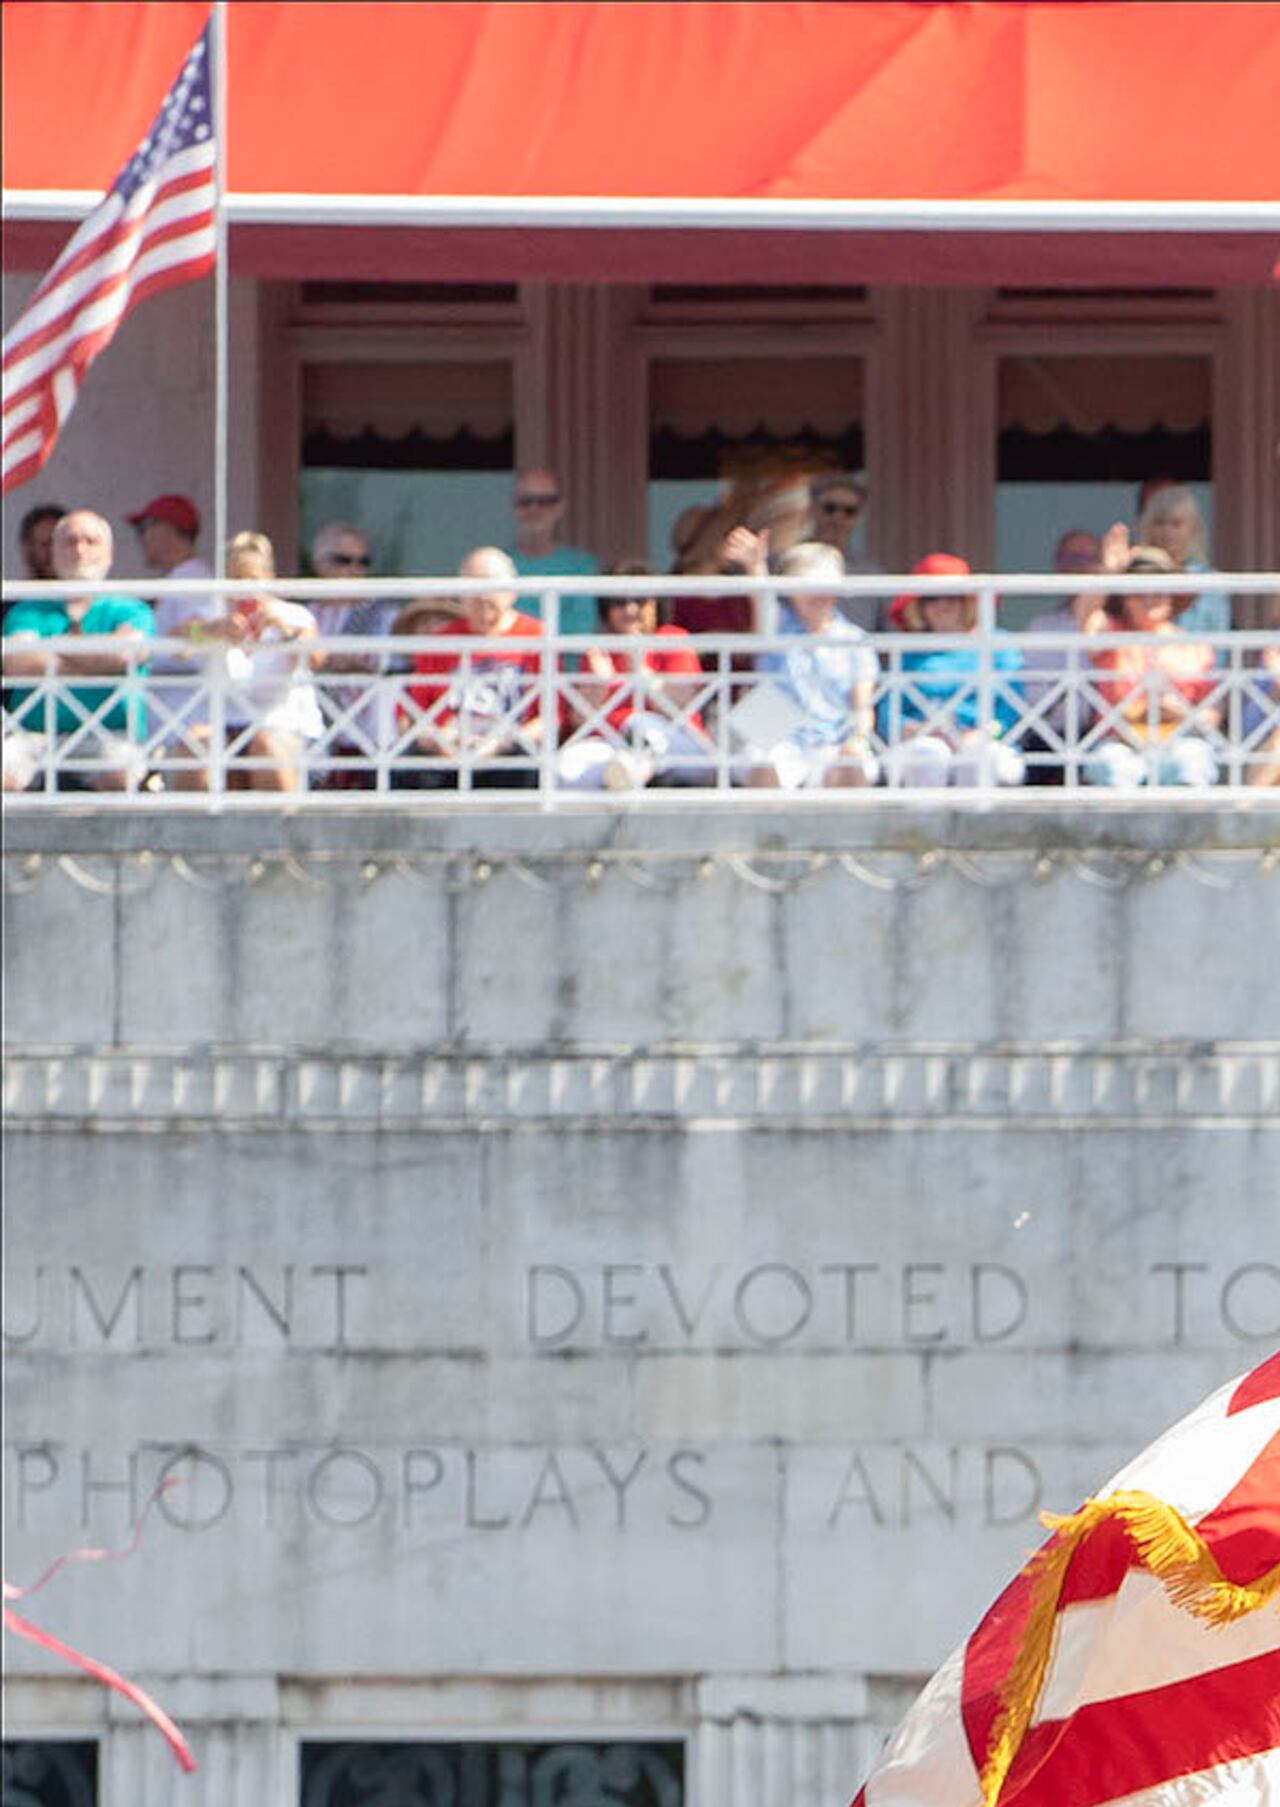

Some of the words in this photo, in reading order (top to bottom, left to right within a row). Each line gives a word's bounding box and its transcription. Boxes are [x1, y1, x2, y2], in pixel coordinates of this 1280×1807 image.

[527, 1262, 1030, 1347] DEVOTED
[17, 1447, 714, 1532] PHOTOPLAYS
[826, 1446, 1043, 1531] AND
